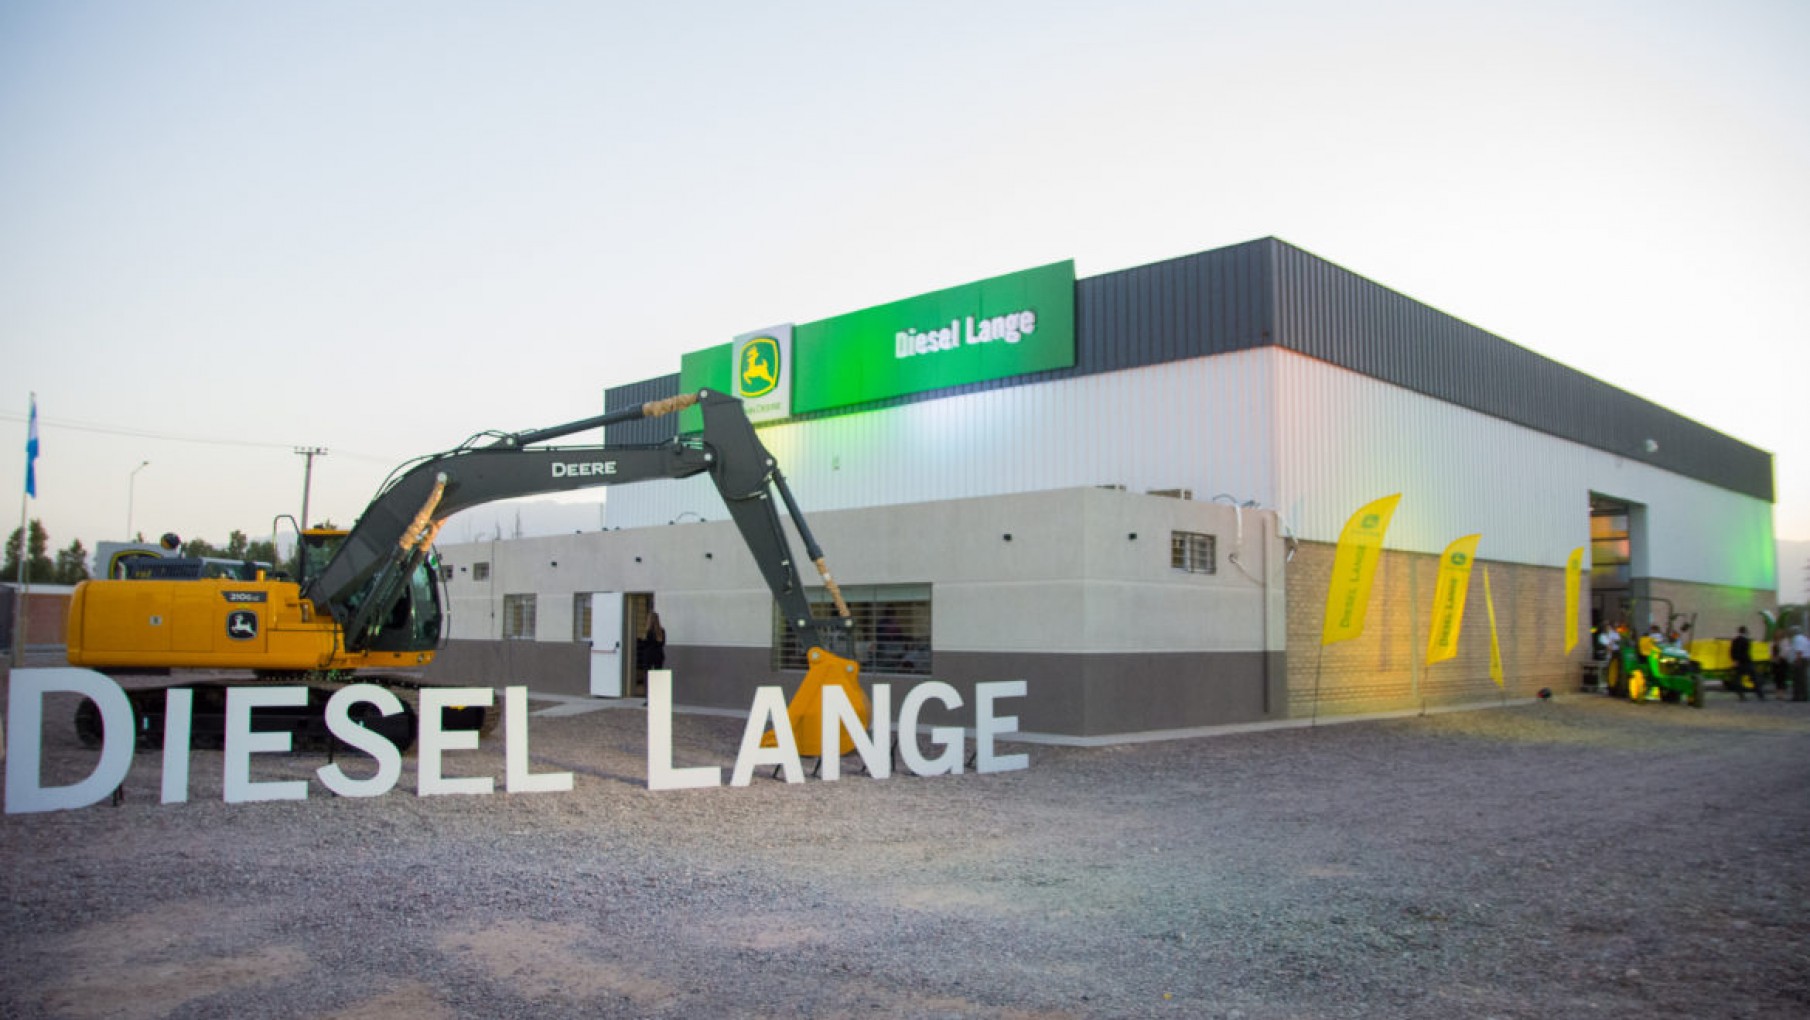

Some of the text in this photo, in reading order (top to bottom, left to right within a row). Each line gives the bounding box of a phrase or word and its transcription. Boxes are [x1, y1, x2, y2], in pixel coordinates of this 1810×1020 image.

[895, 310, 1036, 359] Diesel Lange
[551, 461, 617, 478] DEERE
[4, 667, 1029, 814] DIESEL LANGE
